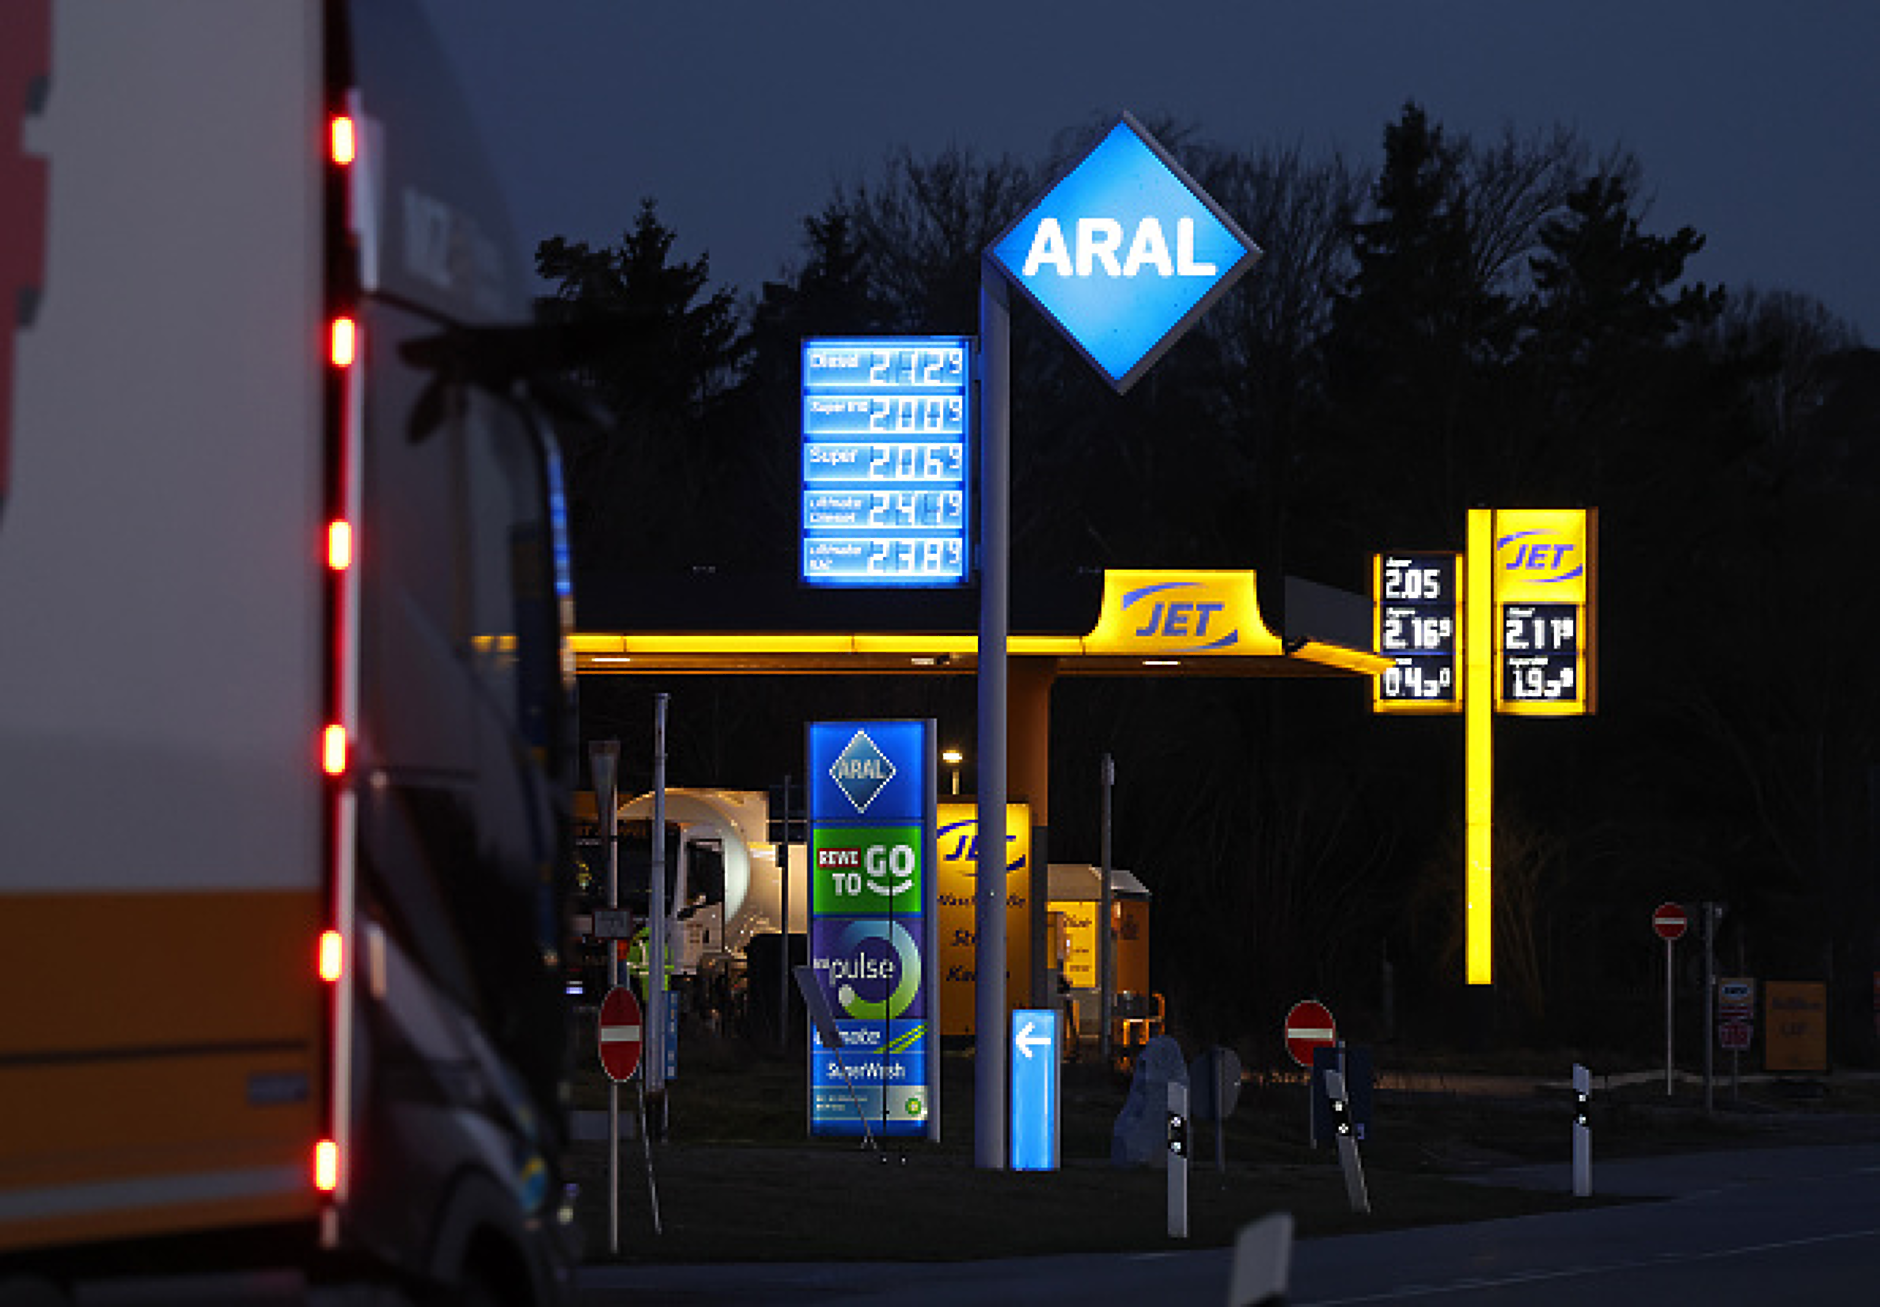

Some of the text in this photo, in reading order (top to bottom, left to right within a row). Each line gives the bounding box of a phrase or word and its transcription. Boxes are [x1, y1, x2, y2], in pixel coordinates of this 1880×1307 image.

[1022, 217, 1218, 277] ARAL
[810, 447, 858, 466] Super
[1505, 544, 1575, 570] JET
[1135, 602, 1225, 637] JET
[838, 759, 887, 779] ARAL
[819, 850, 859, 865] REWE
[864, 844, 915, 877] GO
[832, 872, 862, 896] TO
[830, 952, 894, 987] pulse
